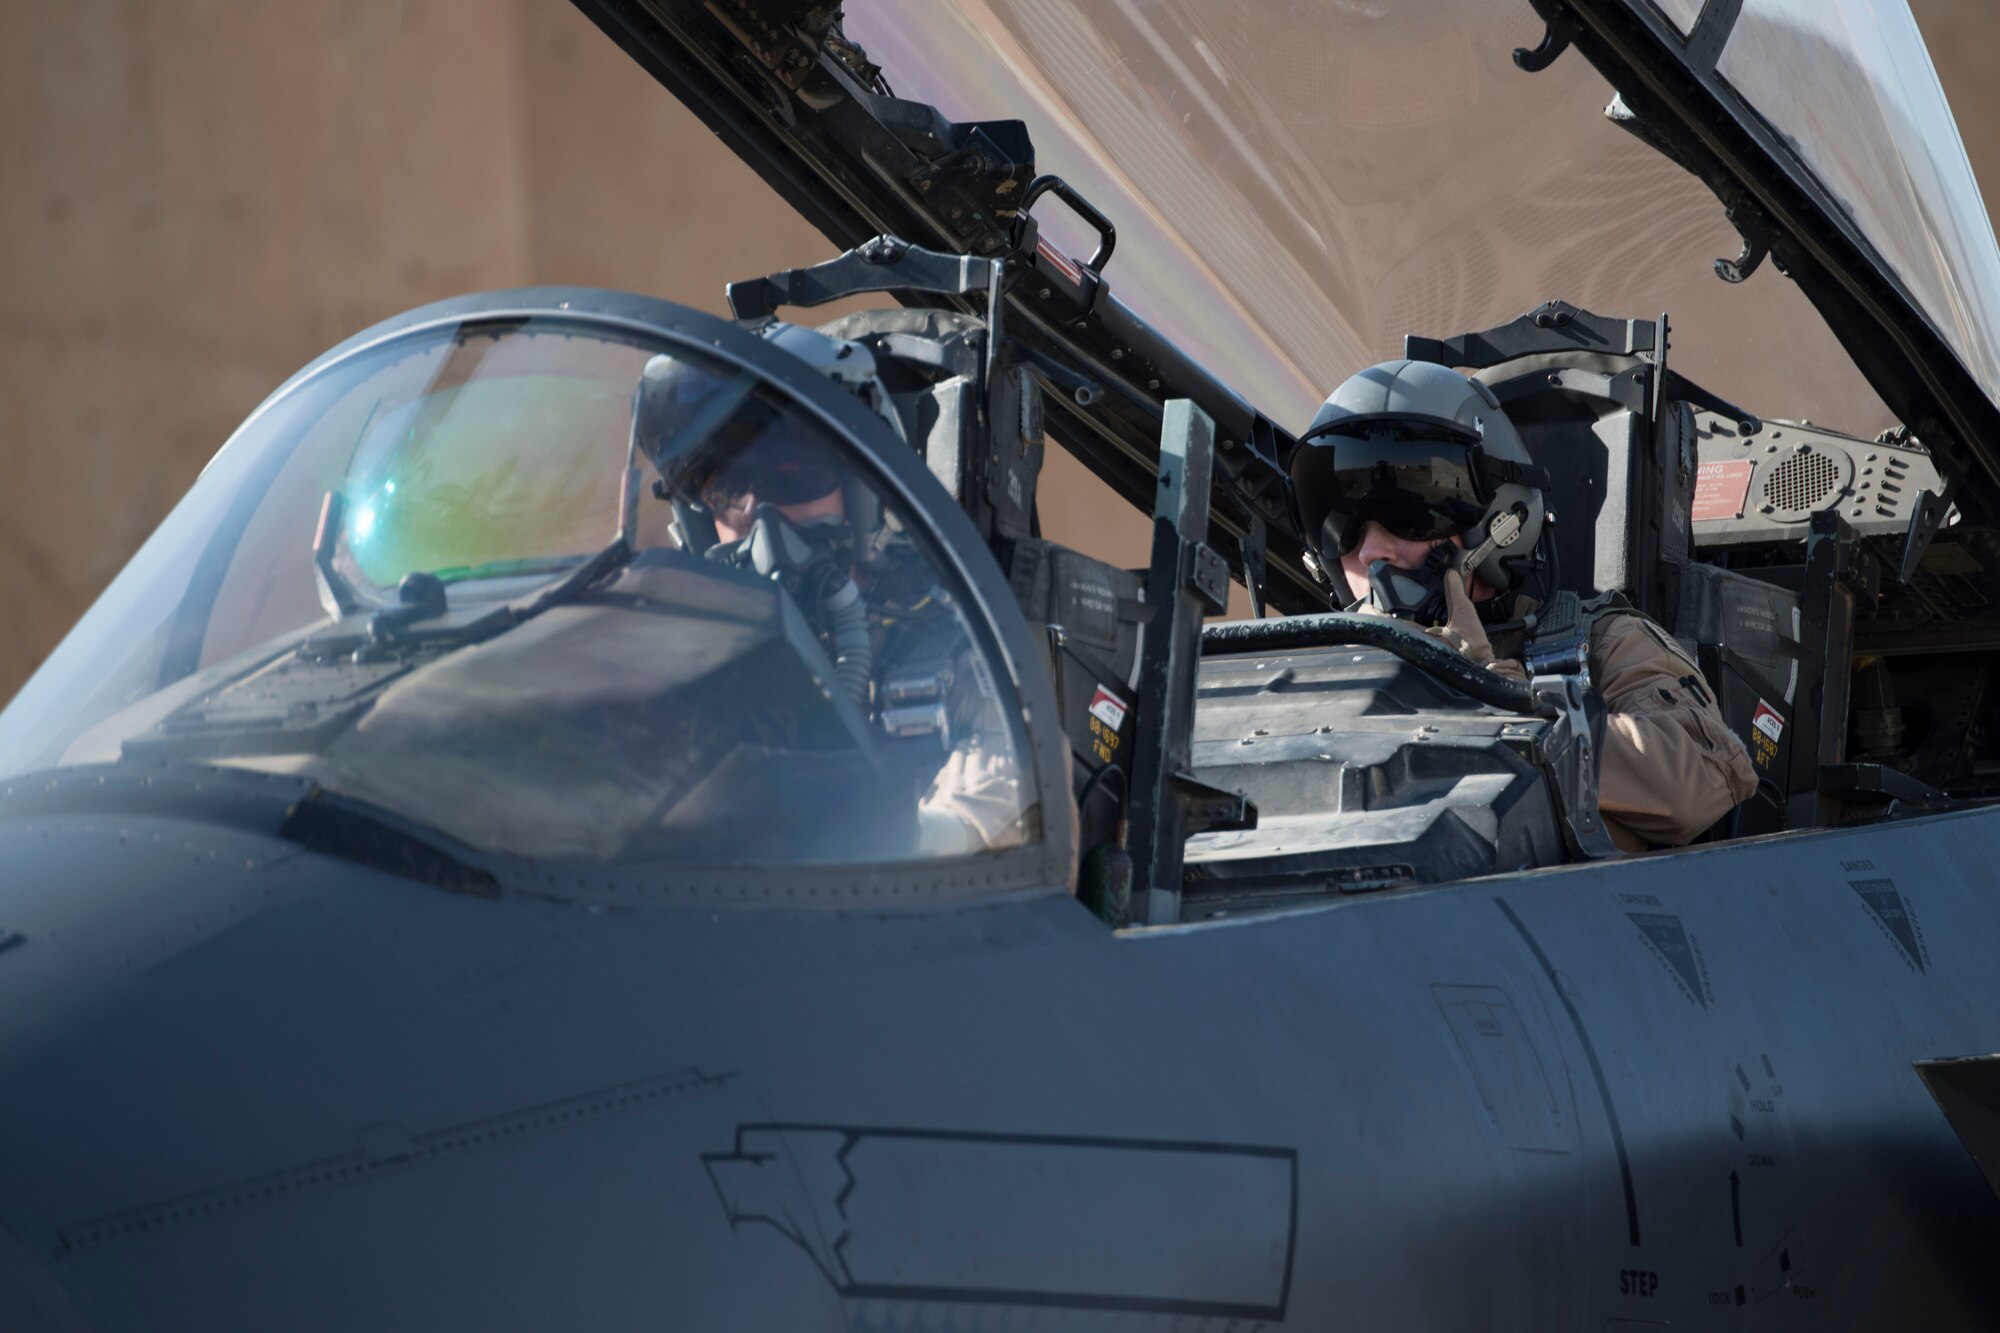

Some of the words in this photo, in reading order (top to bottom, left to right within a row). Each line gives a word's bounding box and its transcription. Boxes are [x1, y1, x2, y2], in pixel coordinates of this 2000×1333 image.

[1093, 738, 1111, 763] FWD
[1756, 749, 1770, 770] AFT
[1839, 859, 1877, 872] DANGER
[1770, 1084, 1784, 1097] UP
[1750, 1100, 1775, 1112] HOLD
[1747, 1153, 1775, 1167] DOWN
[1619, 1268, 1658, 1297] STEP
[1708, 1291, 1731, 1305] LOCK
[1792, 1285, 1816, 1300] PUSH
